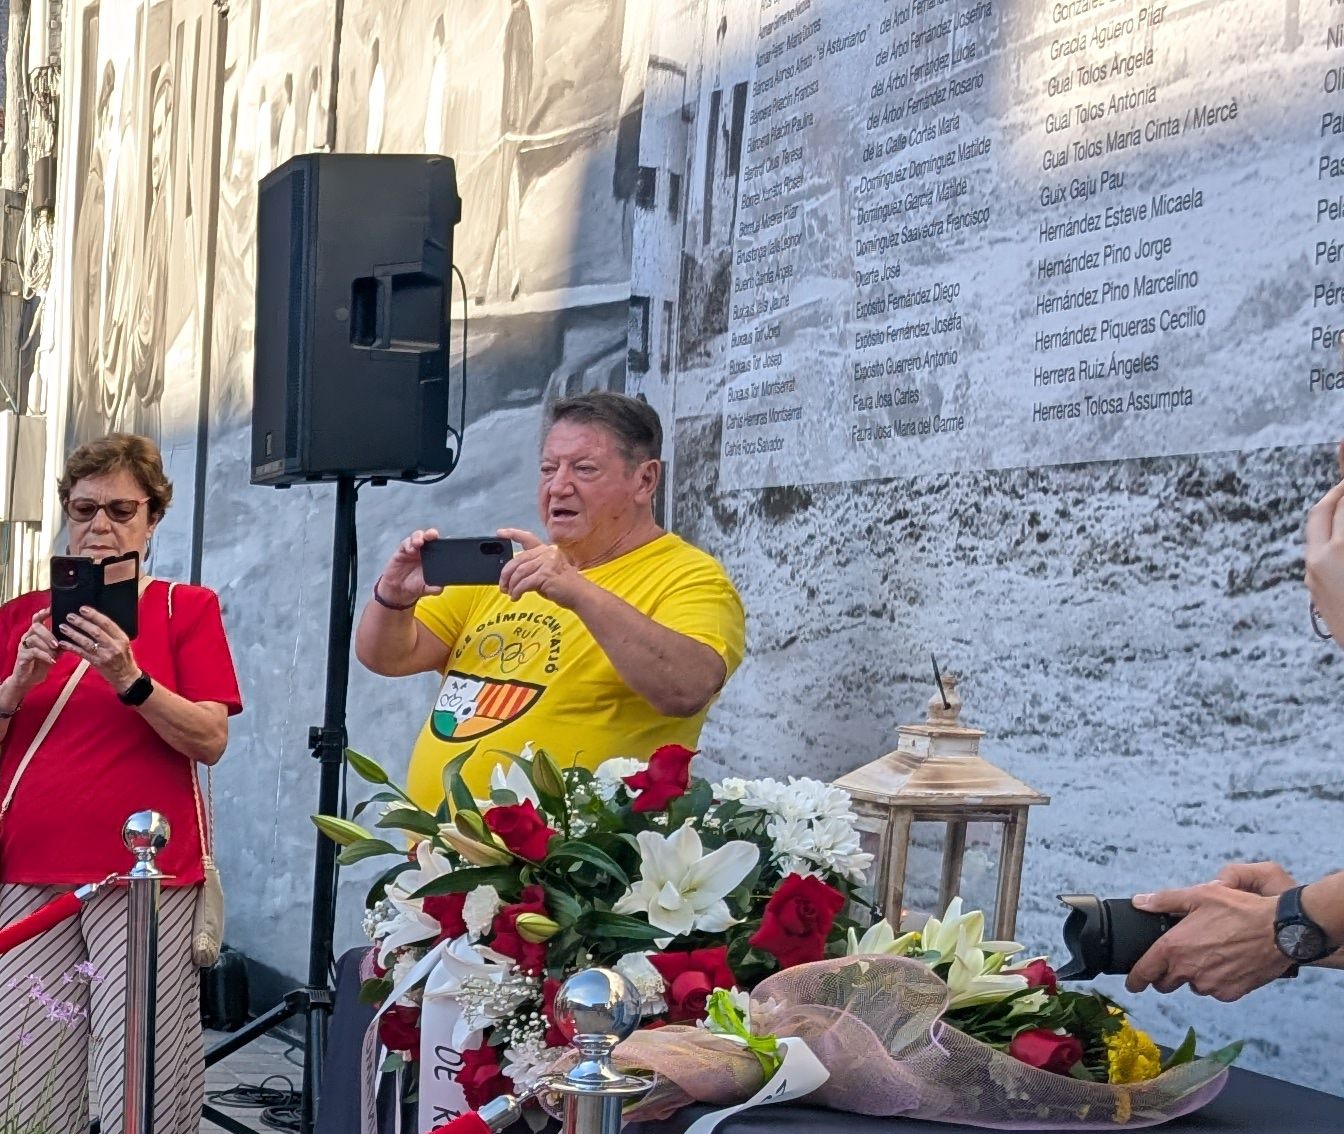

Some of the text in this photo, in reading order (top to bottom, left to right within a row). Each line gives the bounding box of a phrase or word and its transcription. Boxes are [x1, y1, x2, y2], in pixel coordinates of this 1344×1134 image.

[880, 17, 892, 34] del
[1050, 35, 1087, 60] Gracia
[1137, 4, 1167, 31] Pilar
[875, 48, 888, 66] del
[871, 78, 884, 98] del
[1048, 73, 1072, 97] Gual
[1076, 62, 1107, 86] Tolos
[866, 108, 879, 130] del
[949, 71, 983, 99] Rosario
[1046, 82, 1157, 134] Gual Tolos Antònia
[958, 136, 991, 162] Matilde
[1043, 148, 1068, 171] Gual
[1073, 138, 1103, 161] Tolos
[1145, 116, 1180, 142] Cinta
[1183, 109, 1190, 137] /
[1192, 96, 1238, 131] Mercè
[863, 148, 873, 162] de
[876, 143, 883, 157] la
[936, 177, 967, 203] Matilde
[1040, 170, 1124, 207] Guix Gaju Pau
[901, 220, 944, 244] Saavedra
[946, 206, 990, 233] Francisco
[1039, 186, 1203, 243] Hernández Esteve Micaela
[855, 259, 900, 288] Duarte José
[1037, 234, 1171, 279] Hernández Pino Jorge
[887, 286, 931, 311] Fernández
[933, 282, 960, 302] Diego
[1036, 269, 1198, 316] Hernández Pino Marcelino
[886, 318, 929, 342] Fernández
[932, 312, 962, 334] Josefa
[1035, 302, 1206, 351] Hernández Piqueras Cecilio
[886, 354, 921, 376] Guerrero
[922, 346, 958, 369] Antonio
[1033, 350, 1159, 387] Herrera Ruiz Ángeles
[894, 386, 920, 406] Carles
[1033, 385, 1193, 423] Herreras Tolosa Assumpta
[917, 415, 931, 434] del
[932, 414, 964, 433] Carme
